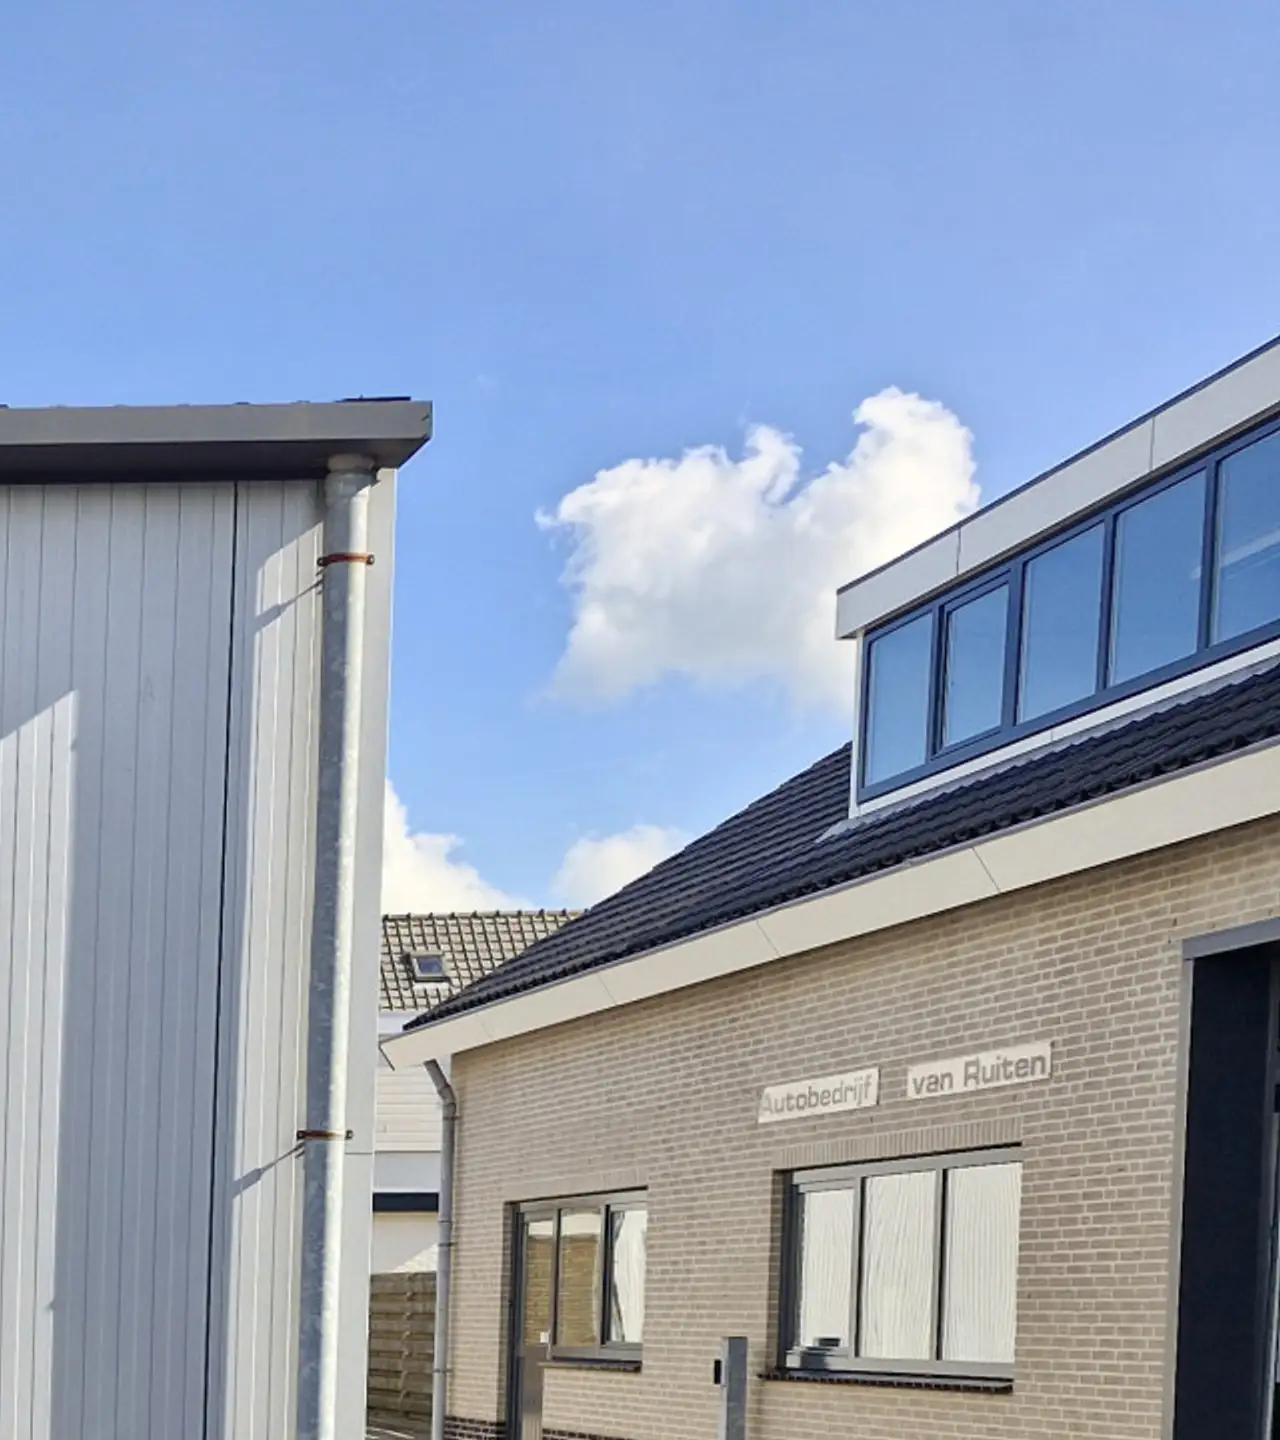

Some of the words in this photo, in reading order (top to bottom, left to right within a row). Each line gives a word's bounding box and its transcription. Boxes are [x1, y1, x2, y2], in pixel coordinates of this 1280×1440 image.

[761, 1074, 873, 1114] Autobedrijf
[912, 1071, 954, 1095] van
[963, 1054, 1047, 1088] Ruiten
